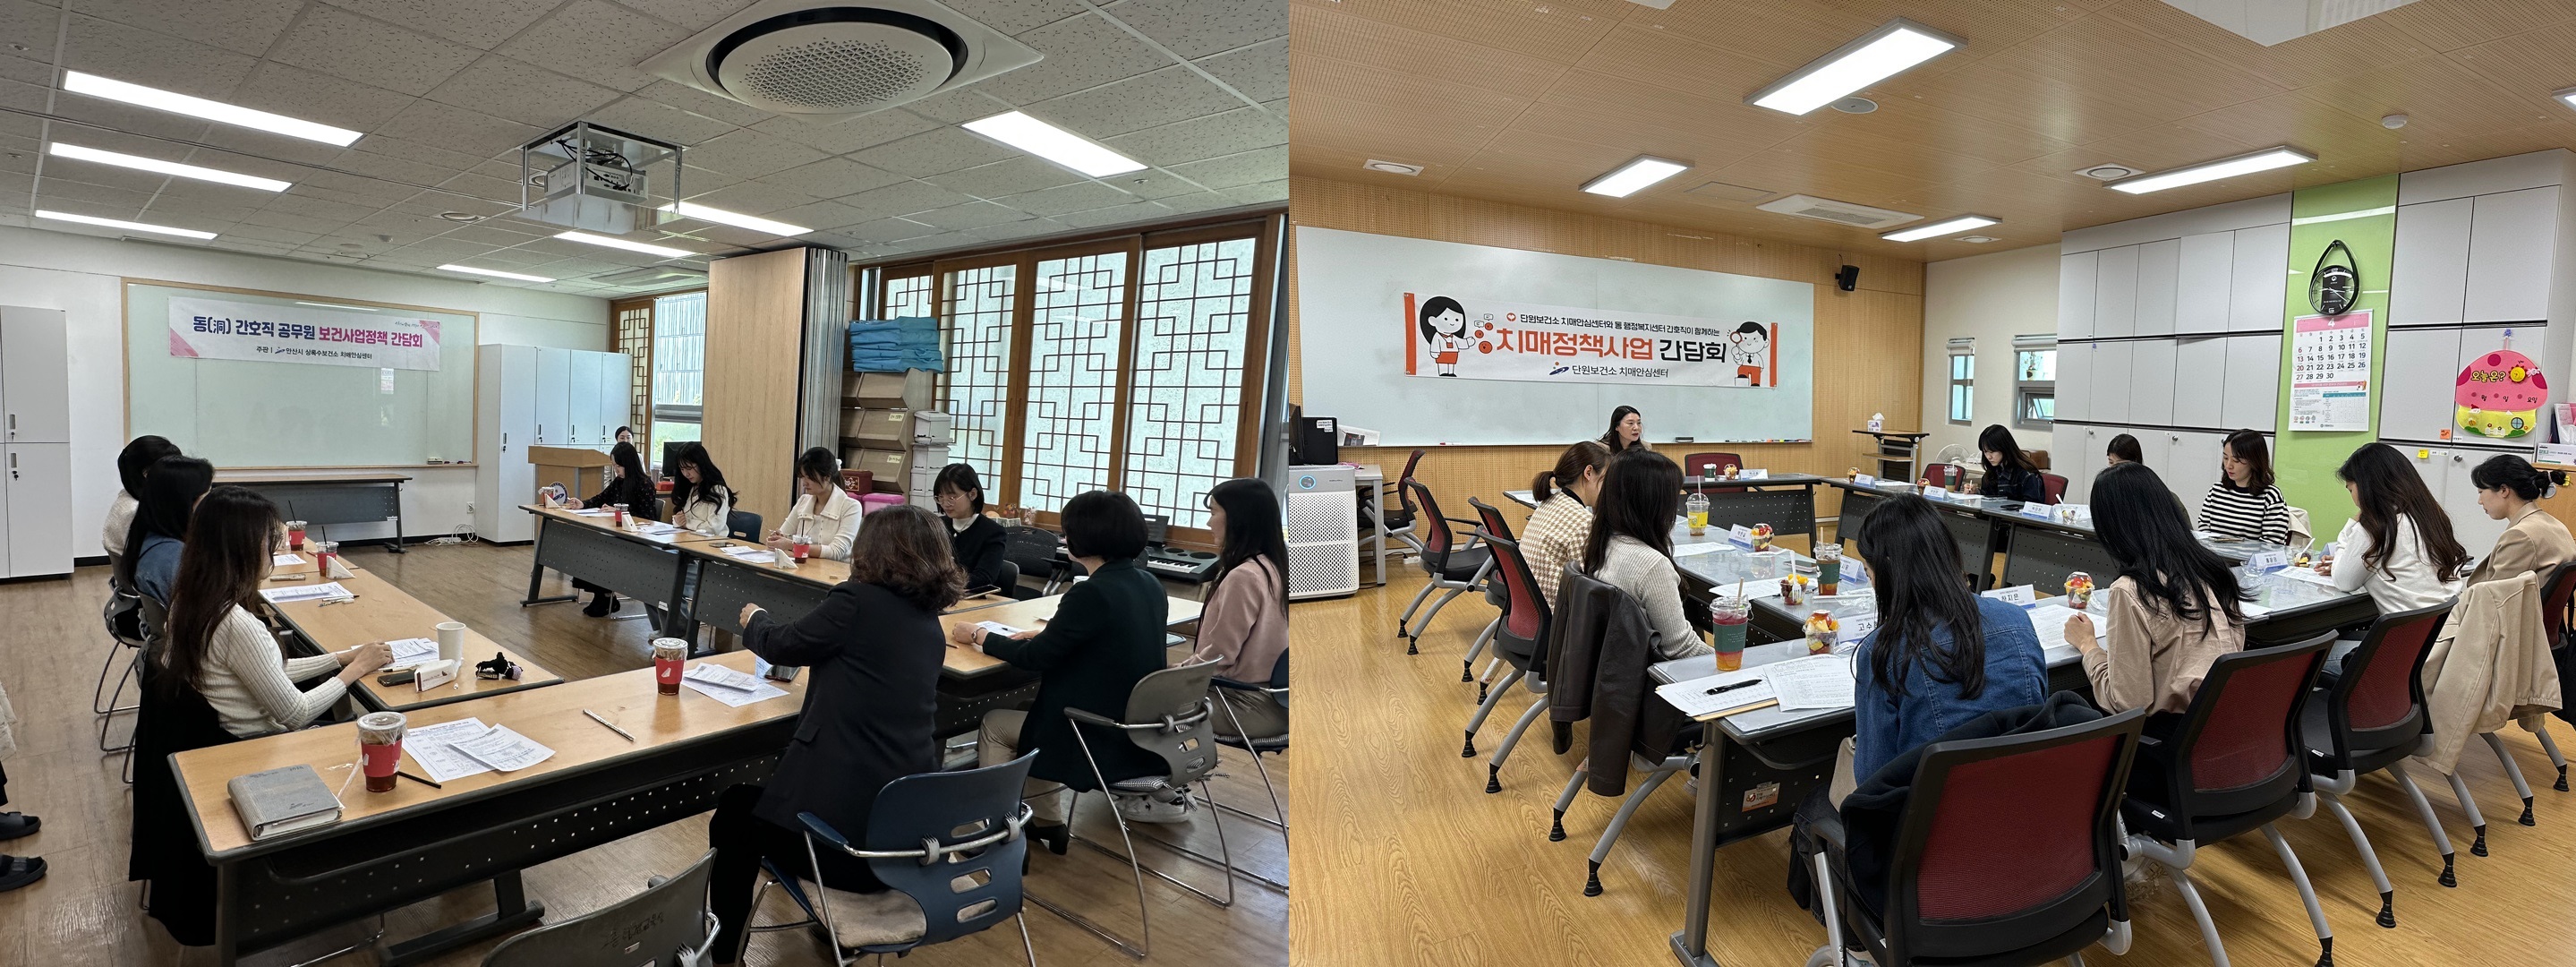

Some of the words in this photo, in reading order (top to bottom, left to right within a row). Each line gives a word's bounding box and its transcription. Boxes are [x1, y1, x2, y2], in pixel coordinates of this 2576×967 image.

[1520, 313, 1559, 325] 단원보건소
[1561, 317, 1613, 329] 치매안심센터와
[1624, 321, 1666, 333] 행정복지센터
[1667, 325, 1693, 335] 간호직이
[1694, 327, 1720, 337] 함께하는
[2327, 318, 2335, 327] 4
[193, 315, 232, 335] 동(洞)
[235, 319, 275, 338] 간호직
[278, 322, 316, 340] 공무원
[319, 326, 388, 346] 보건사업정책
[391, 331, 422, 348] 간담회
[1497, 327, 1653, 361] 치매정책사업
[1659, 338, 1727, 364] 간담회
[286, 347, 303, 355] 안산시
[304, 348, 339, 357] 상록수보건소
[340, 351, 372, 359] 치매안심센터
[1572, 364, 1617, 375] 단원보건소
[1619, 366, 1669, 378] 치매안심센터
[2470, 369, 2506, 383] 오늘은?
